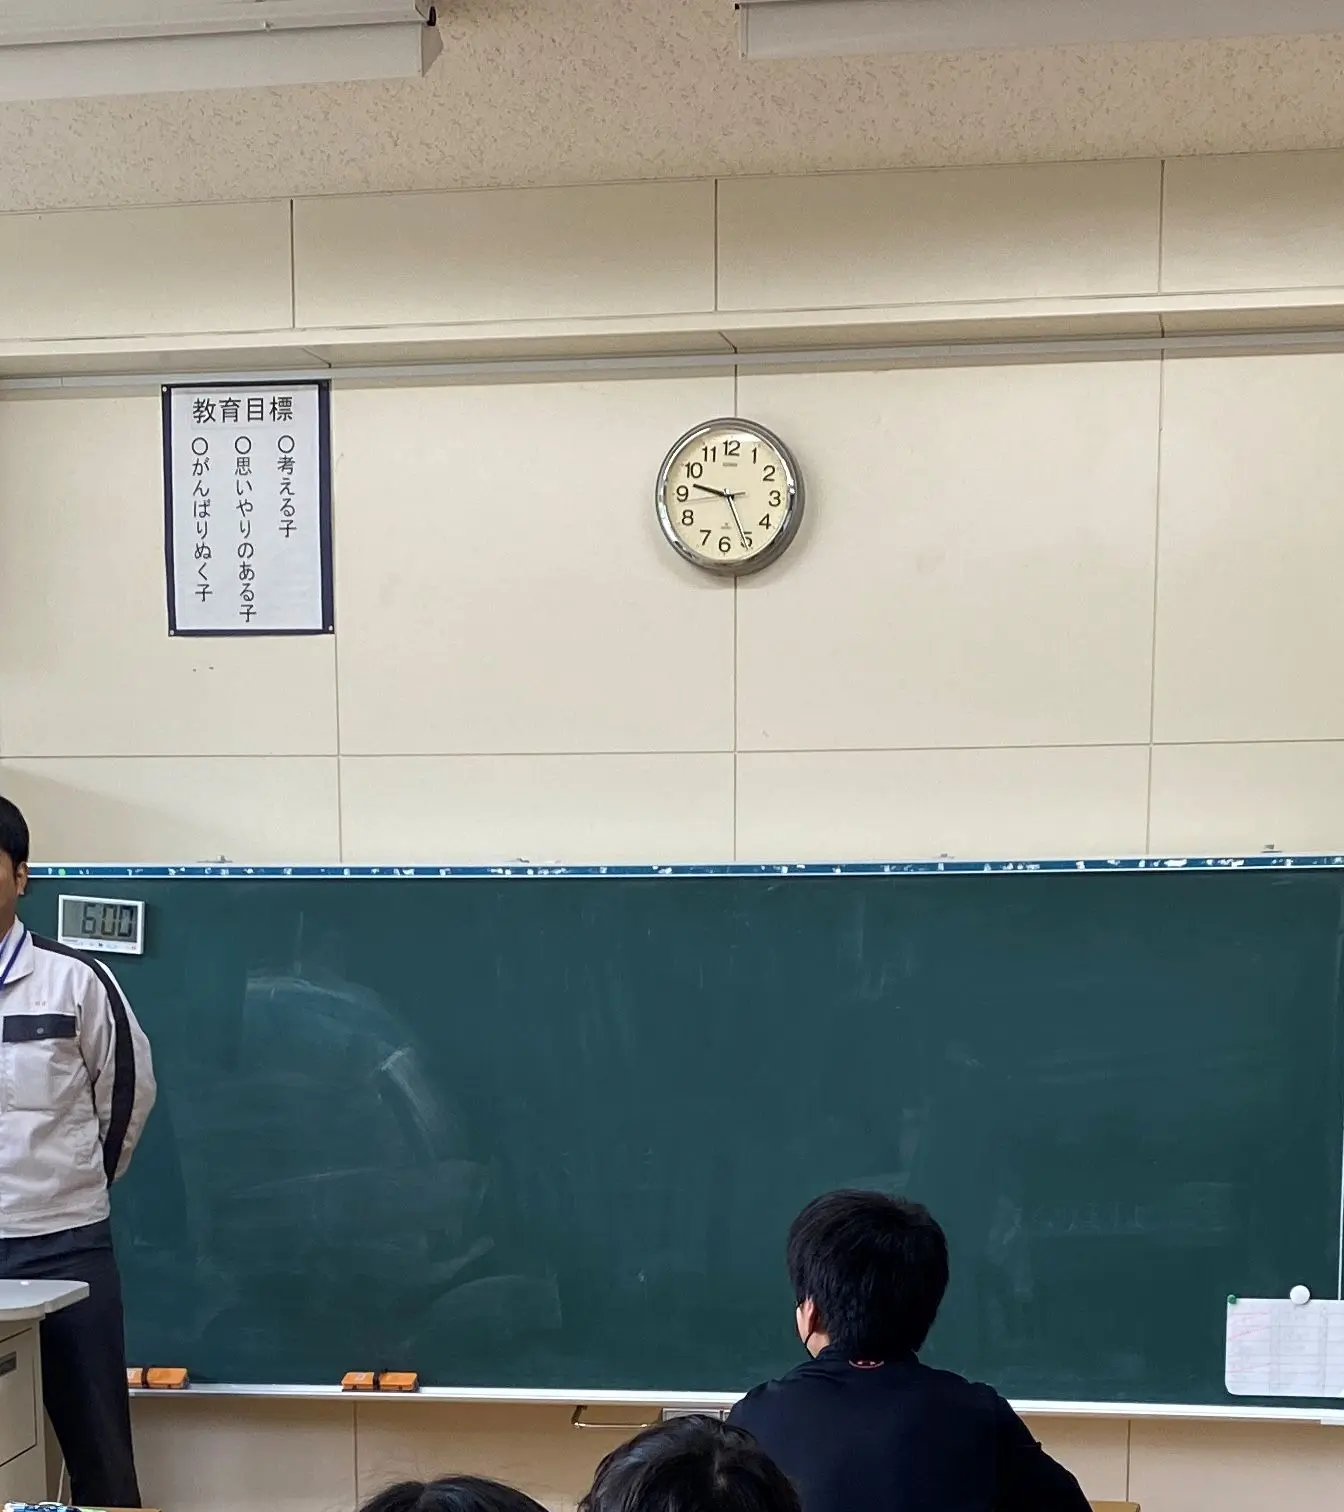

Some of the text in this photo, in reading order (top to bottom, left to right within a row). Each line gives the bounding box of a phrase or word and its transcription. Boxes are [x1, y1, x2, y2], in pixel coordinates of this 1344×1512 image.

[193, 395, 294, 424] 教育目標
[701, 446, 717, 463] 11
[723, 440, 741, 457] 12
[751, 447, 757, 465] 1
[684, 462, 704, 479] 10
[762, 465, 776, 482] 2
[676, 485, 689, 502] 9
[768, 490, 782, 507] 3
[681, 509, 694, 526] 8
[758, 513, 772, 530] 4
[699, 530, 712, 546] 7
[718, 536, 731, 553] 6
